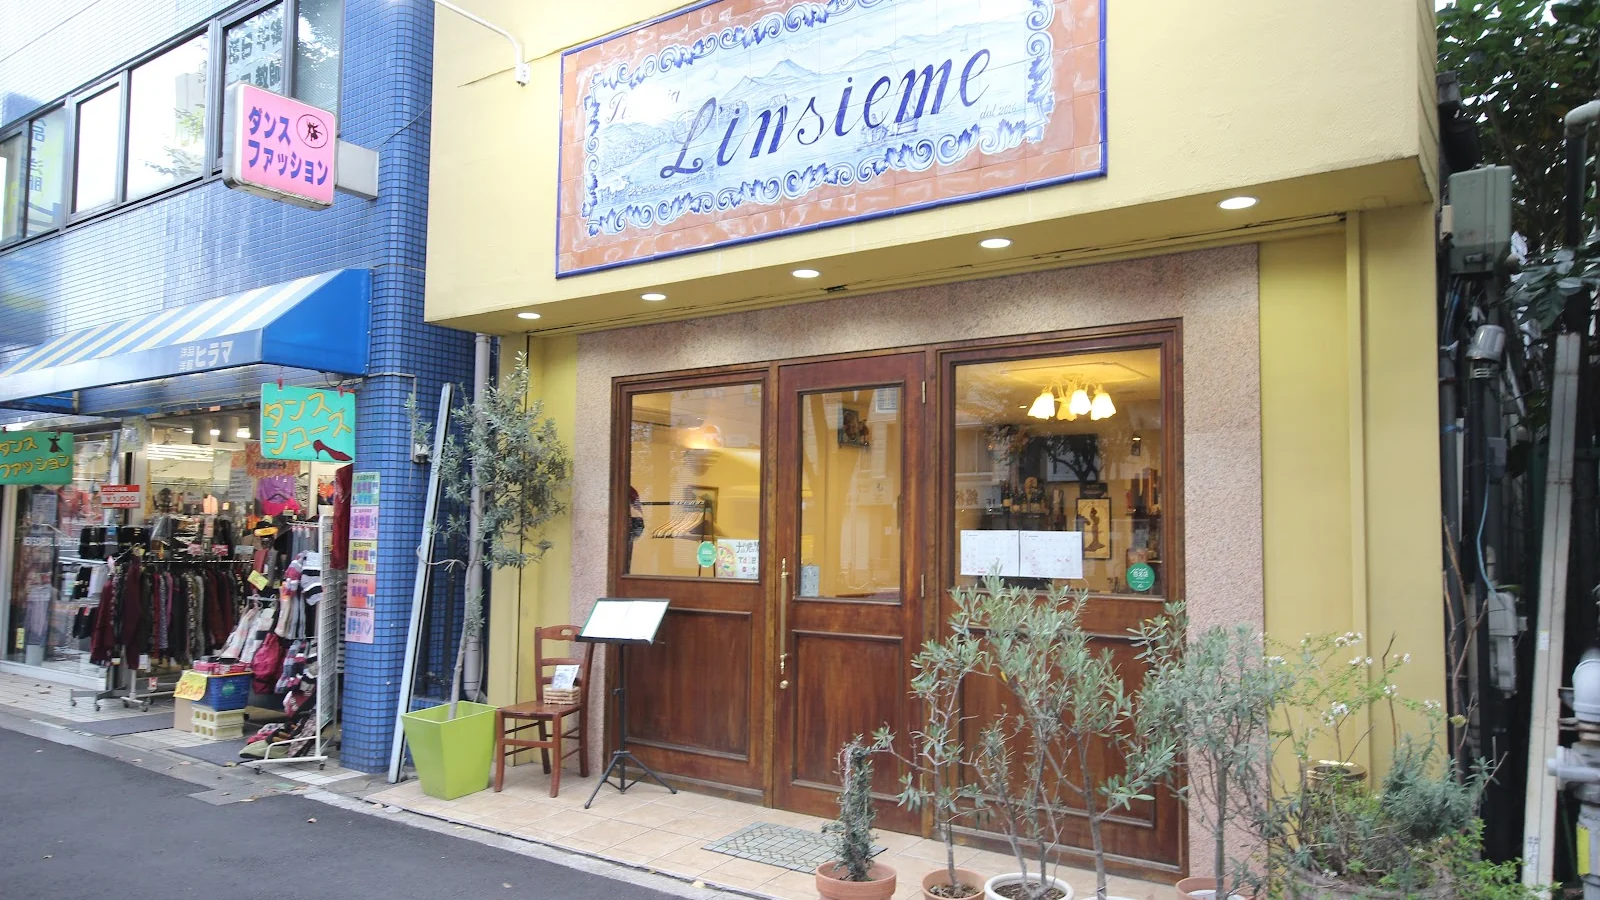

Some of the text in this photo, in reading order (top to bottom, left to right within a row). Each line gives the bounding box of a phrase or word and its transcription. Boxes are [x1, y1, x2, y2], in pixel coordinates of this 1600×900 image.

[248, 106, 291, 145] ダンス
[248, 139, 328, 185] ファッション
[195, 341, 233, 368] ヒラマ
[264, 392, 333, 428] ダンス
[264, 408, 352, 455] シューズ
[0, 455, 70, 479] ファッション
